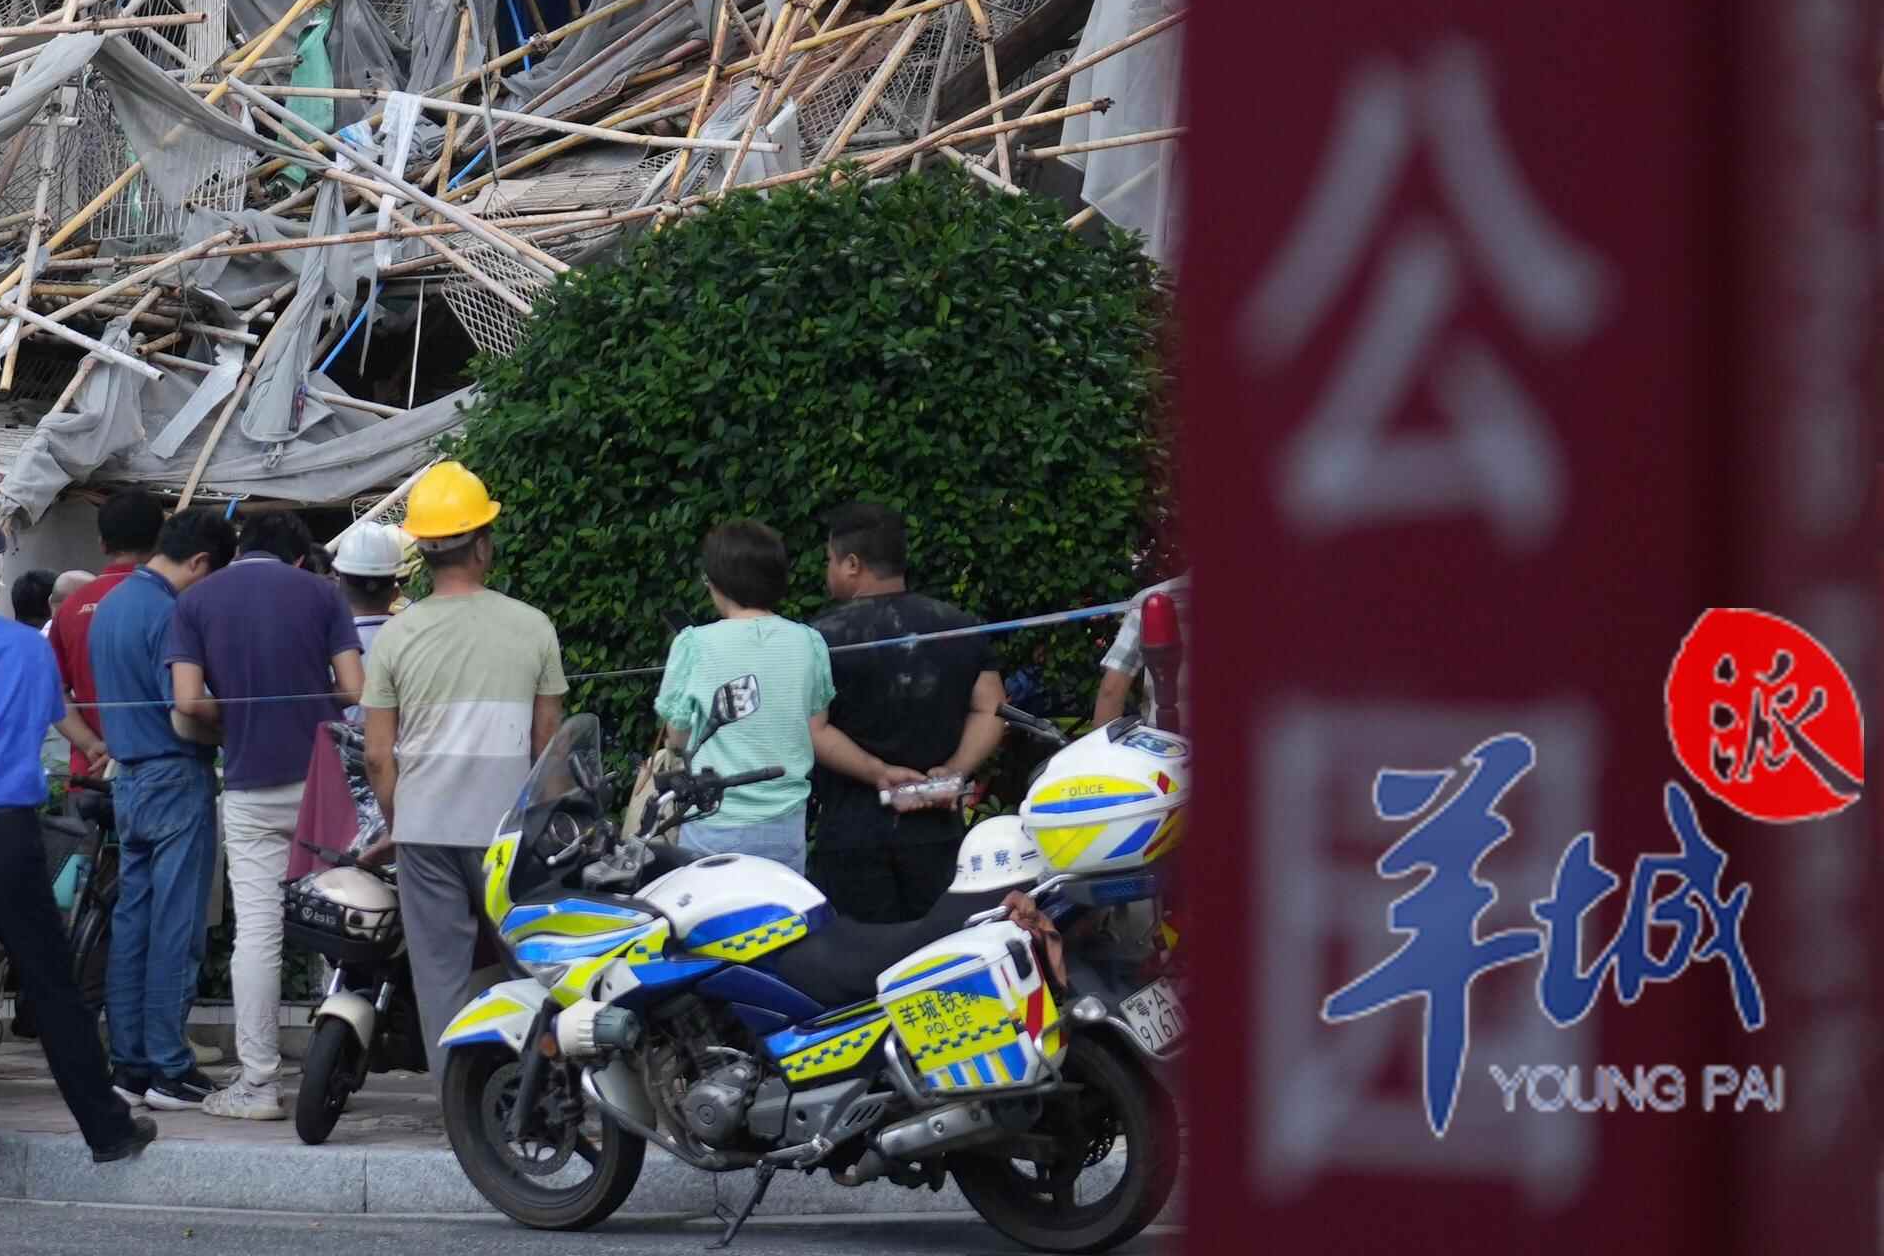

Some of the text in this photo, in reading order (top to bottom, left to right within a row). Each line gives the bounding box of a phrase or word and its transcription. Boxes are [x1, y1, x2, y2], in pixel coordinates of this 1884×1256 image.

[1061, 783, 1106, 797] OLICE
[969, 849, 1011, 873] 警察
[924, 1010, 975, 1038] POLCE
